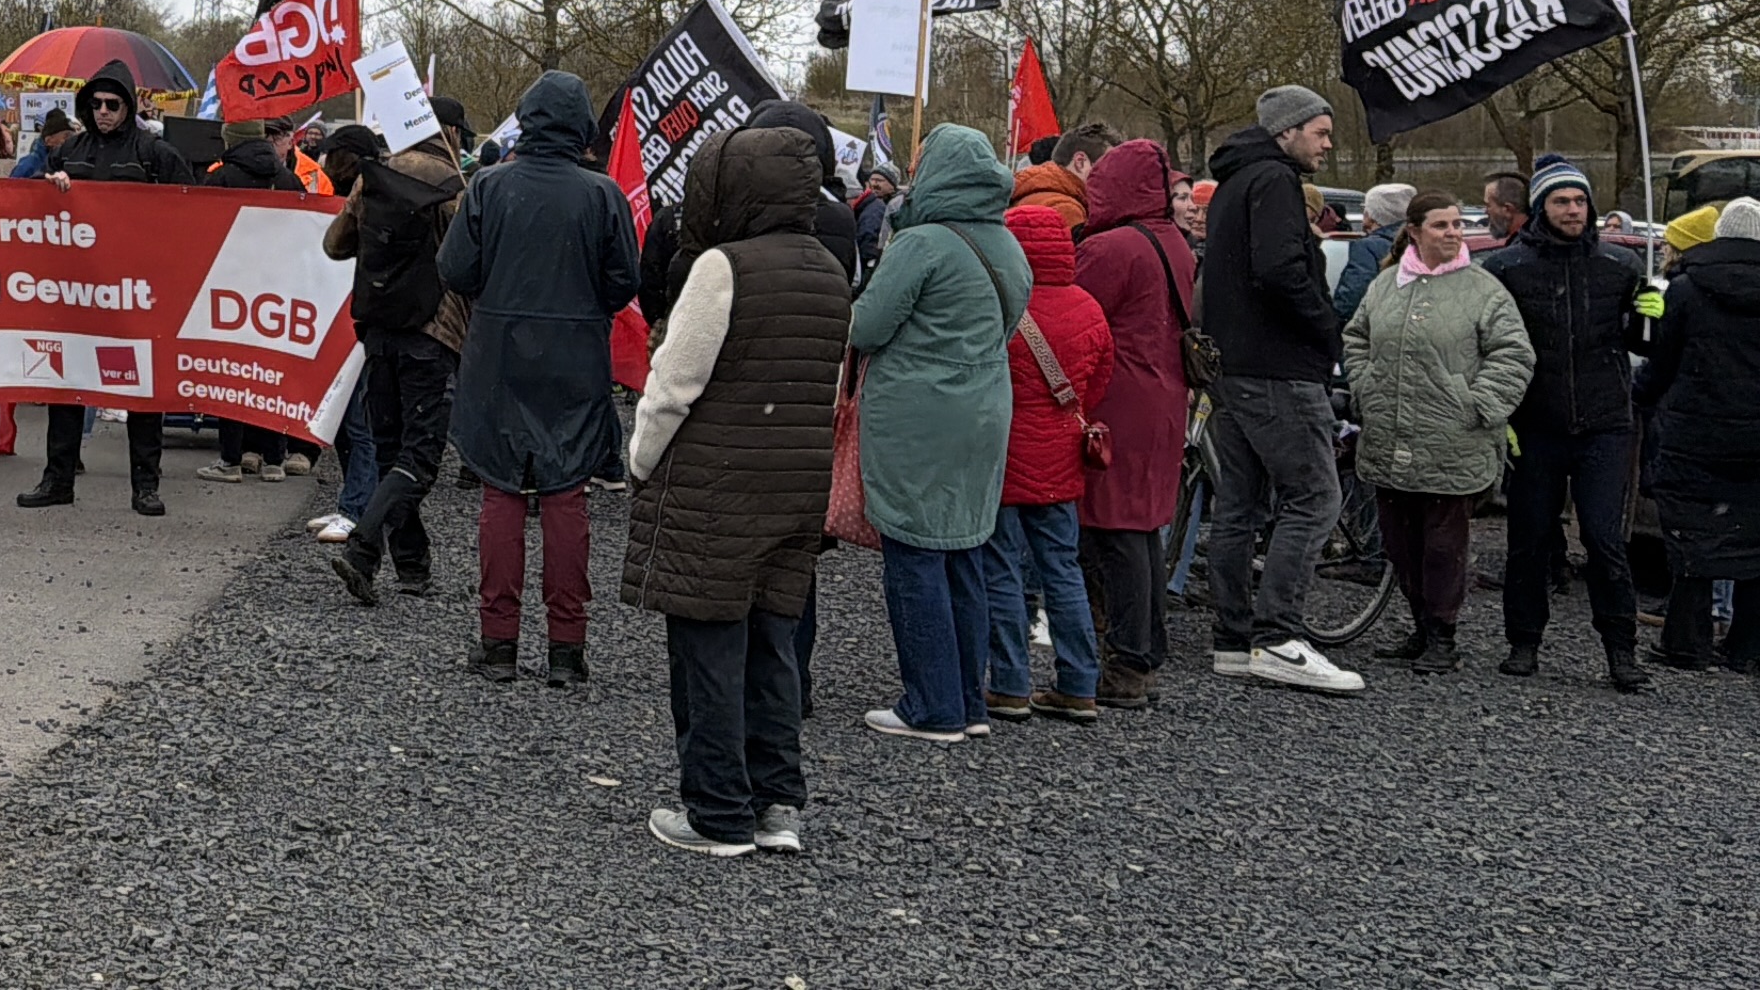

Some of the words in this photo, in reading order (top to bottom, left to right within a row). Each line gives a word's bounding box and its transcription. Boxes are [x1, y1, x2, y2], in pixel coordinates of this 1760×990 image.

[6, 271, 154, 311] Gewalt
[209, 288, 318, 347] DGB
[36, 340, 63, 353] NGG
[177, 353, 285, 387] Deutscher
[177, 379, 315, 423] Gewerkschaft
